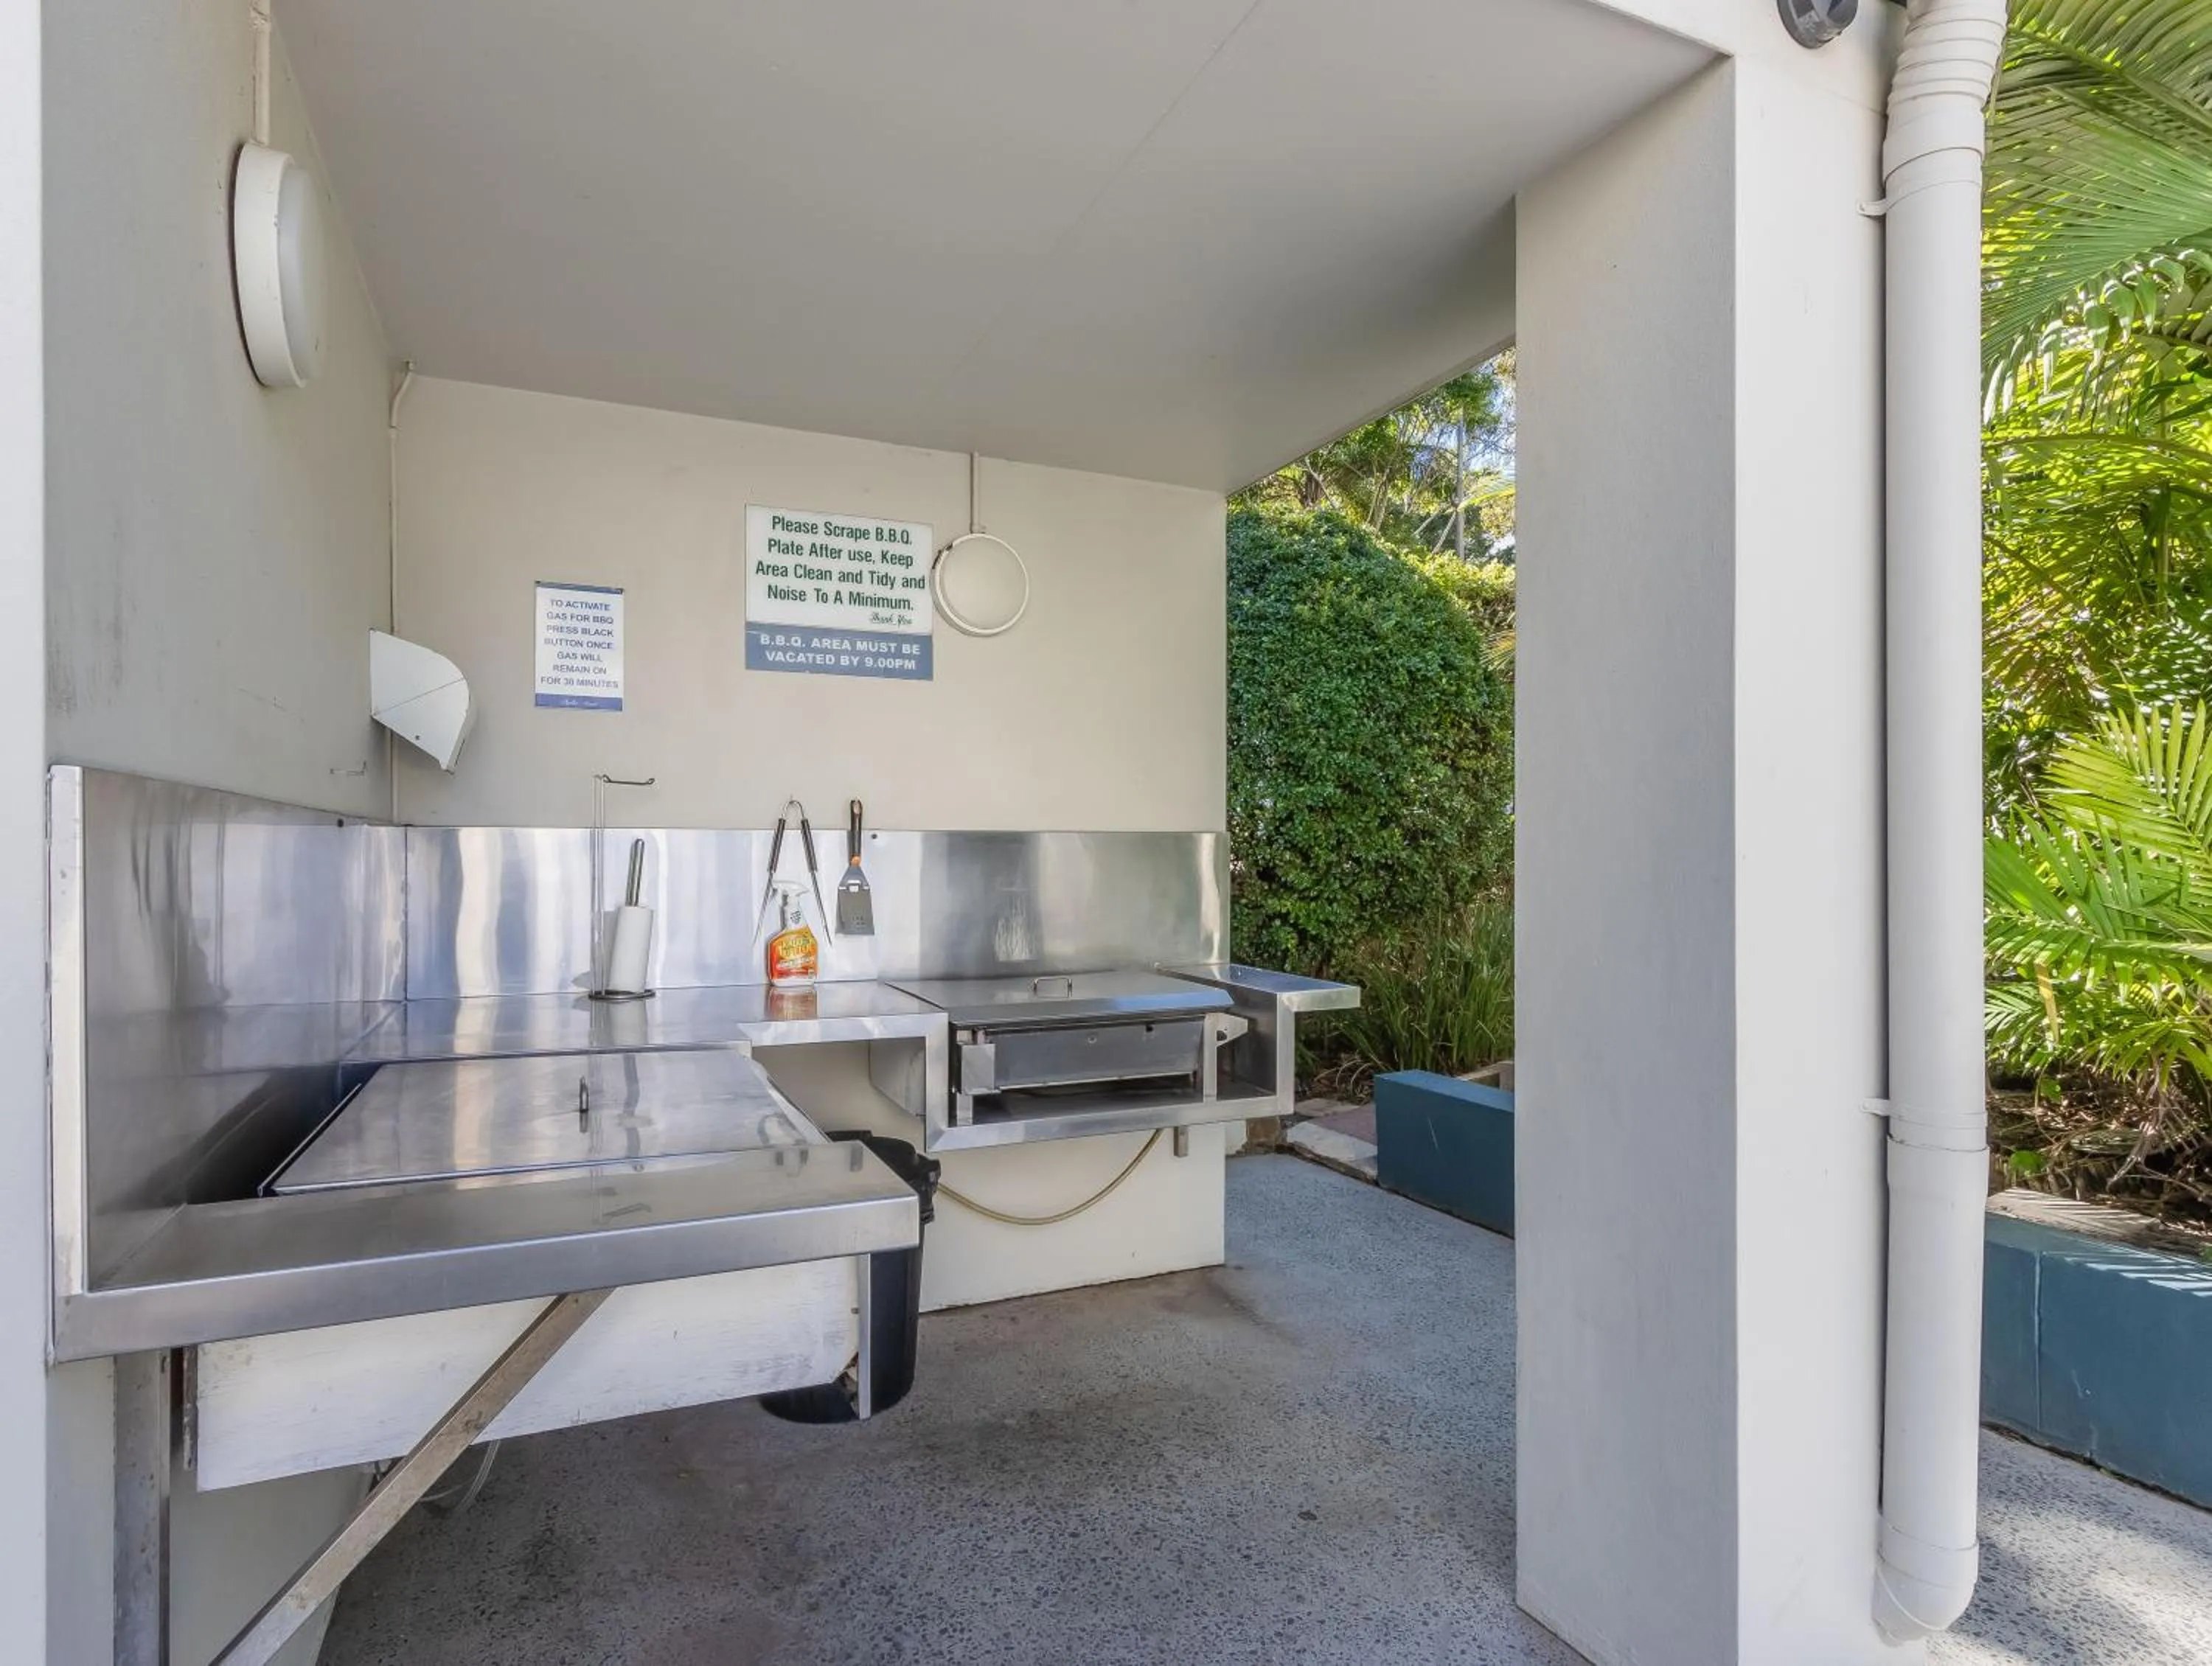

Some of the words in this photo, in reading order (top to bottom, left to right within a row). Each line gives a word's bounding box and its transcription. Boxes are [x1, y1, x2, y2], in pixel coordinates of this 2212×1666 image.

[772, 515, 818, 534] Please
[824, 521, 871, 543] Scrape
[875, 527, 912, 545] B.B.Q.
[768, 538, 804, 556] Plate
[809, 543, 843, 560] After
[849, 549, 875, 565] use,
[881, 550, 914, 569] Keep
[756, 560, 788, 577] Area
[794, 564, 832, 581] Clean
[838, 568, 863, 584] and
[868, 571, 896, 590] Tidy
[902, 576, 925, 589] and
[768, 585, 807, 602] Noise
[813, 588, 828, 604] To
[833, 590, 843, 604] A
[849, 590, 914, 611] Minimum.
[550, 599, 563, 607] TO
[565, 601, 611, 611] ACTIVATE
[546, 611, 567, 620] GAS
[570, 613, 591, 623] FOR
[592, 616, 614, 624] BBQ
[546, 624, 579, 635] PRESS
[580, 627, 614, 637] BLACK
[544, 638, 584, 648] BUTTON
[586, 640, 613, 649] ONCE
[760, 633, 806, 647] B.B.Q.
[811, 638, 852, 651] AREA
[856, 639, 897, 653] MUST
[902, 644, 921, 655] BE
[557, 652, 578, 661] GAS
[580, 653, 603, 662] WILL
[765, 650, 835, 665] VACATED
[840, 655, 860, 666] BY
[864, 657, 916, 670] 9.00PM
[553, 664, 590, 674] REMAIN
[592, 666, 607, 675] ON
[540, 676, 561, 685] FOR
[576, 679, 619, 689] MINUTES
